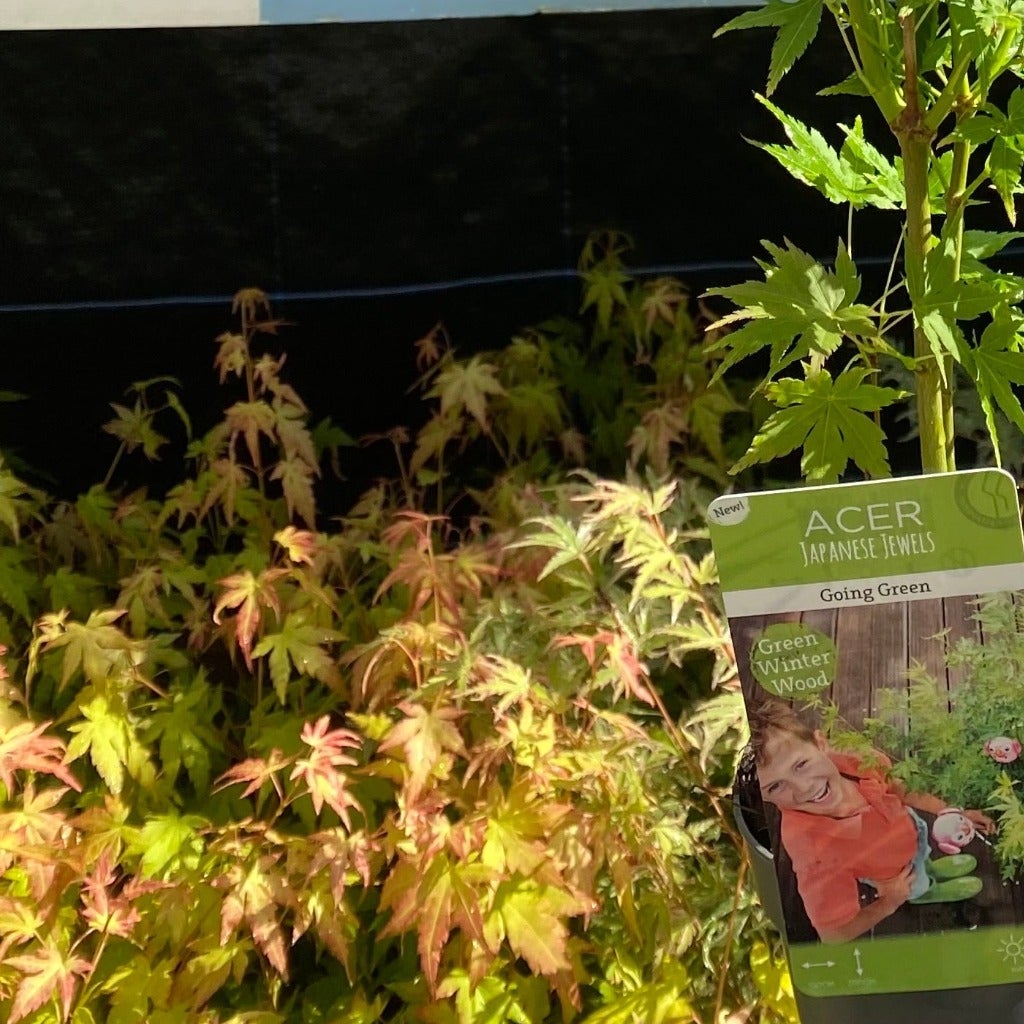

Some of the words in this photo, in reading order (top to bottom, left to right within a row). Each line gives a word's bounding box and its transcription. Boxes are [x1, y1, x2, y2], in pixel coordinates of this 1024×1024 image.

[713, 500, 745, 518] New!
[804, 500, 924, 538] ACER
[799, 537, 879, 568] JAPANESE
[880, 531, 936, 559] JEWELS
[820, 586, 875, 603] Going
[877, 581, 932, 597] Green
[758, 633, 819, 655] Green
[756, 652, 831, 676] Winter
[771, 670, 831, 695] Wood
